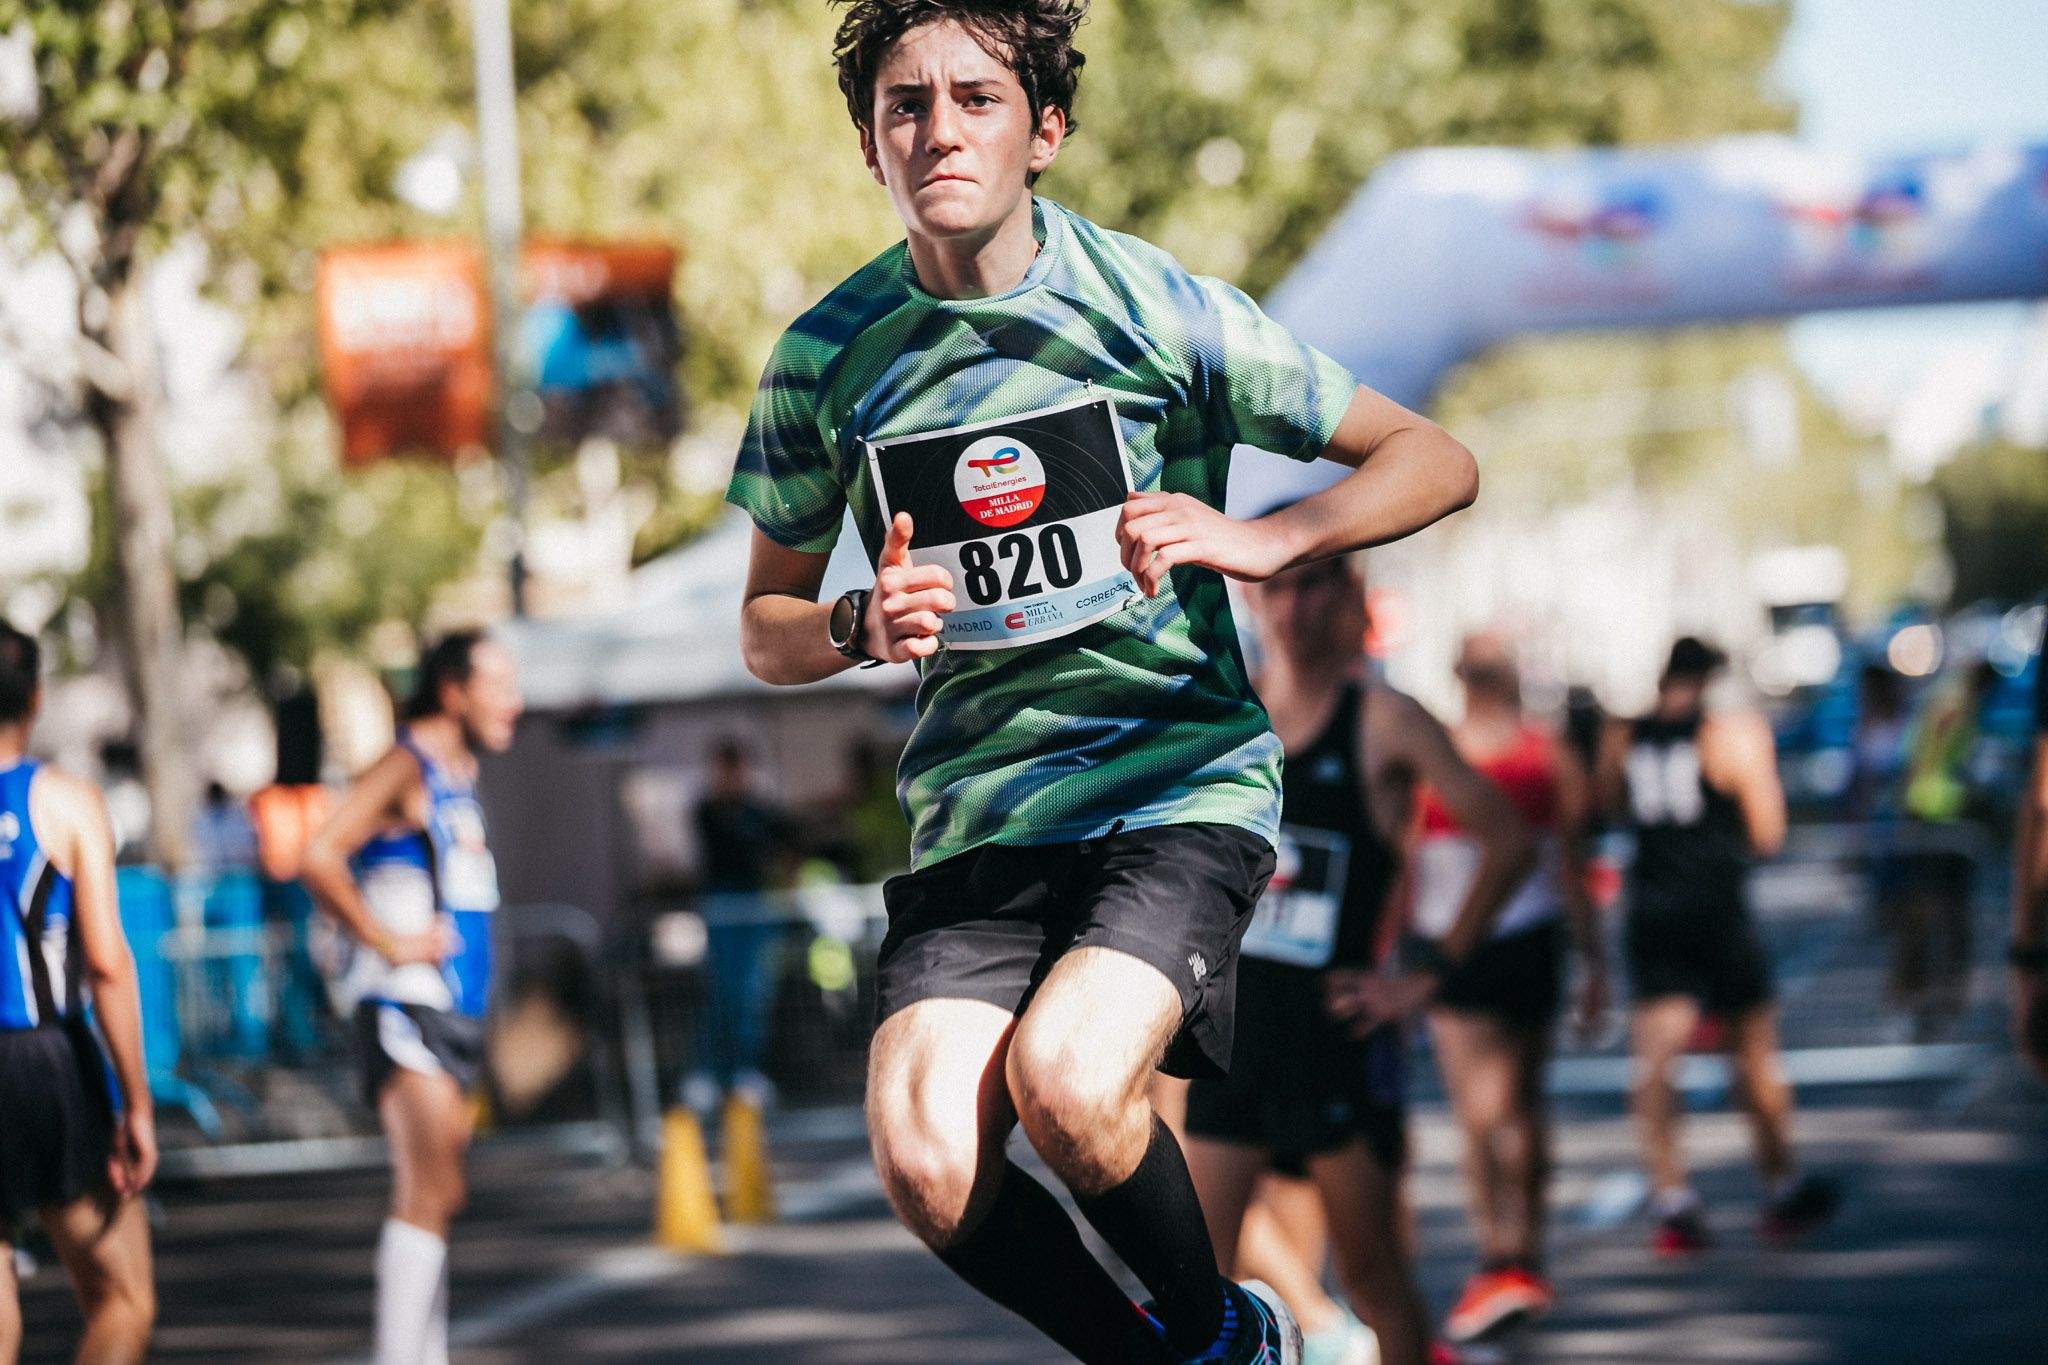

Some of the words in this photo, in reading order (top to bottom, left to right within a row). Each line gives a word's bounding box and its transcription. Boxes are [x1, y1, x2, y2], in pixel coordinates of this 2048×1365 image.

[973, 476, 1027, 493] TotalEnergies
[988, 494, 1020, 508] MILLA
[979, 509, 995, 520] DE
[995, 500, 1034, 516] MADRID
[959, 523, 1083, 606] 820
[1076, 579, 1133, 609] CORREDOR
[1025, 604, 1058, 617] MILLA
[1027, 611, 1065, 626] URBANA
[948, 620, 992, 633] MADRID
